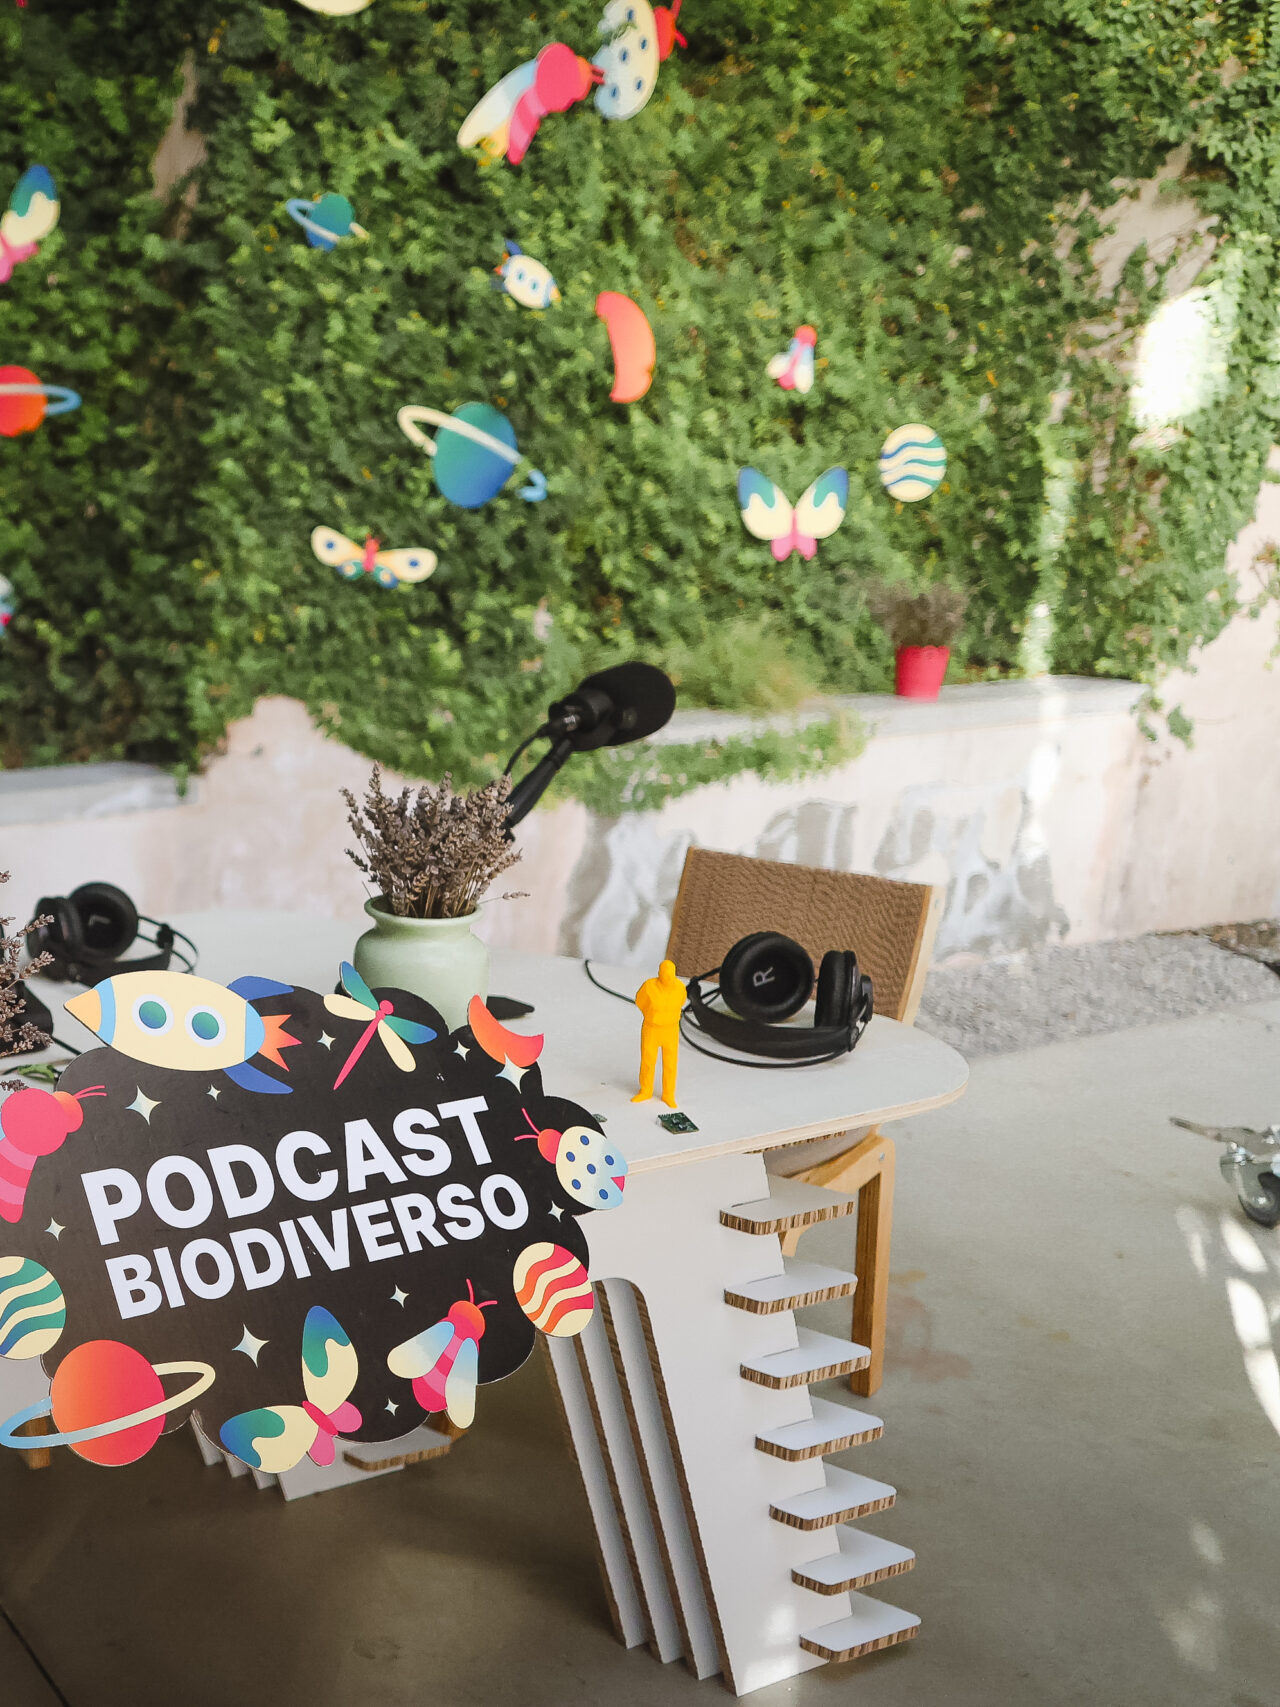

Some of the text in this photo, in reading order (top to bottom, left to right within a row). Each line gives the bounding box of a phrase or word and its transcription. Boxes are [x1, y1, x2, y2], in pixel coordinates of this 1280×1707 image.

[752, 966, 776, 988] R
[80, 1095, 492, 1246] PODCAST
[104, 1173, 529, 1320] BIODIVERSO
